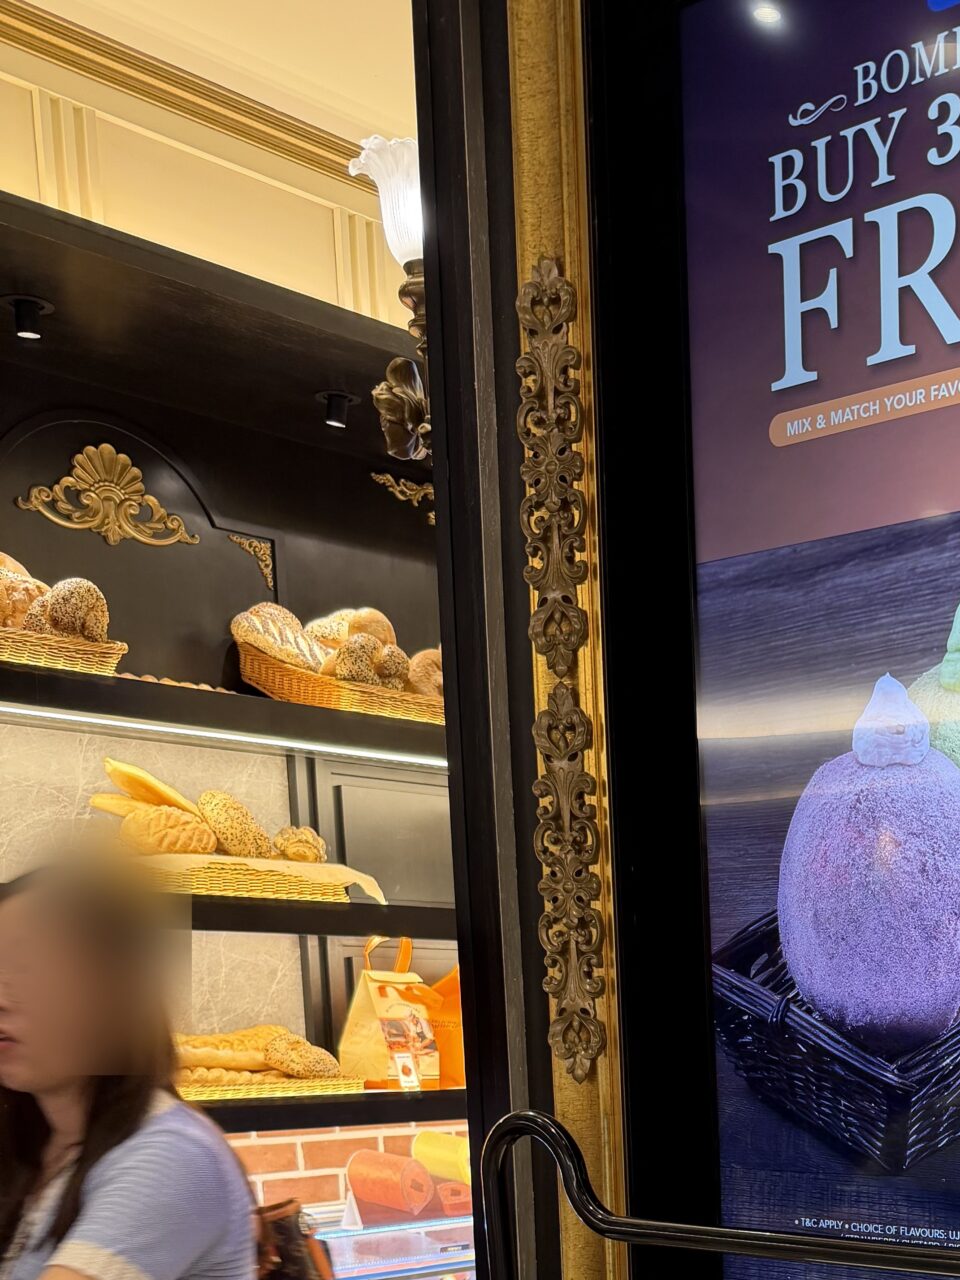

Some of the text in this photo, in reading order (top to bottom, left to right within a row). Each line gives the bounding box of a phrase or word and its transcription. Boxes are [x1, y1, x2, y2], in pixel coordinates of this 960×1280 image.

[768, 108, 907, 222] BUY
[786, 416, 813, 438] MIX
[816, 413, 827, 430] &
[830, 400, 880, 427] MATCH
[884, 388, 926, 413] YOUR
[800, 1217, 818, 1228] T&C
[818, 1219, 843, 1230] APPLY
[850, 1222, 884, 1235] CHOICE
[885, 1225, 898, 1235] OF
[900, 1226, 947, 1240] FLAVOURS:
